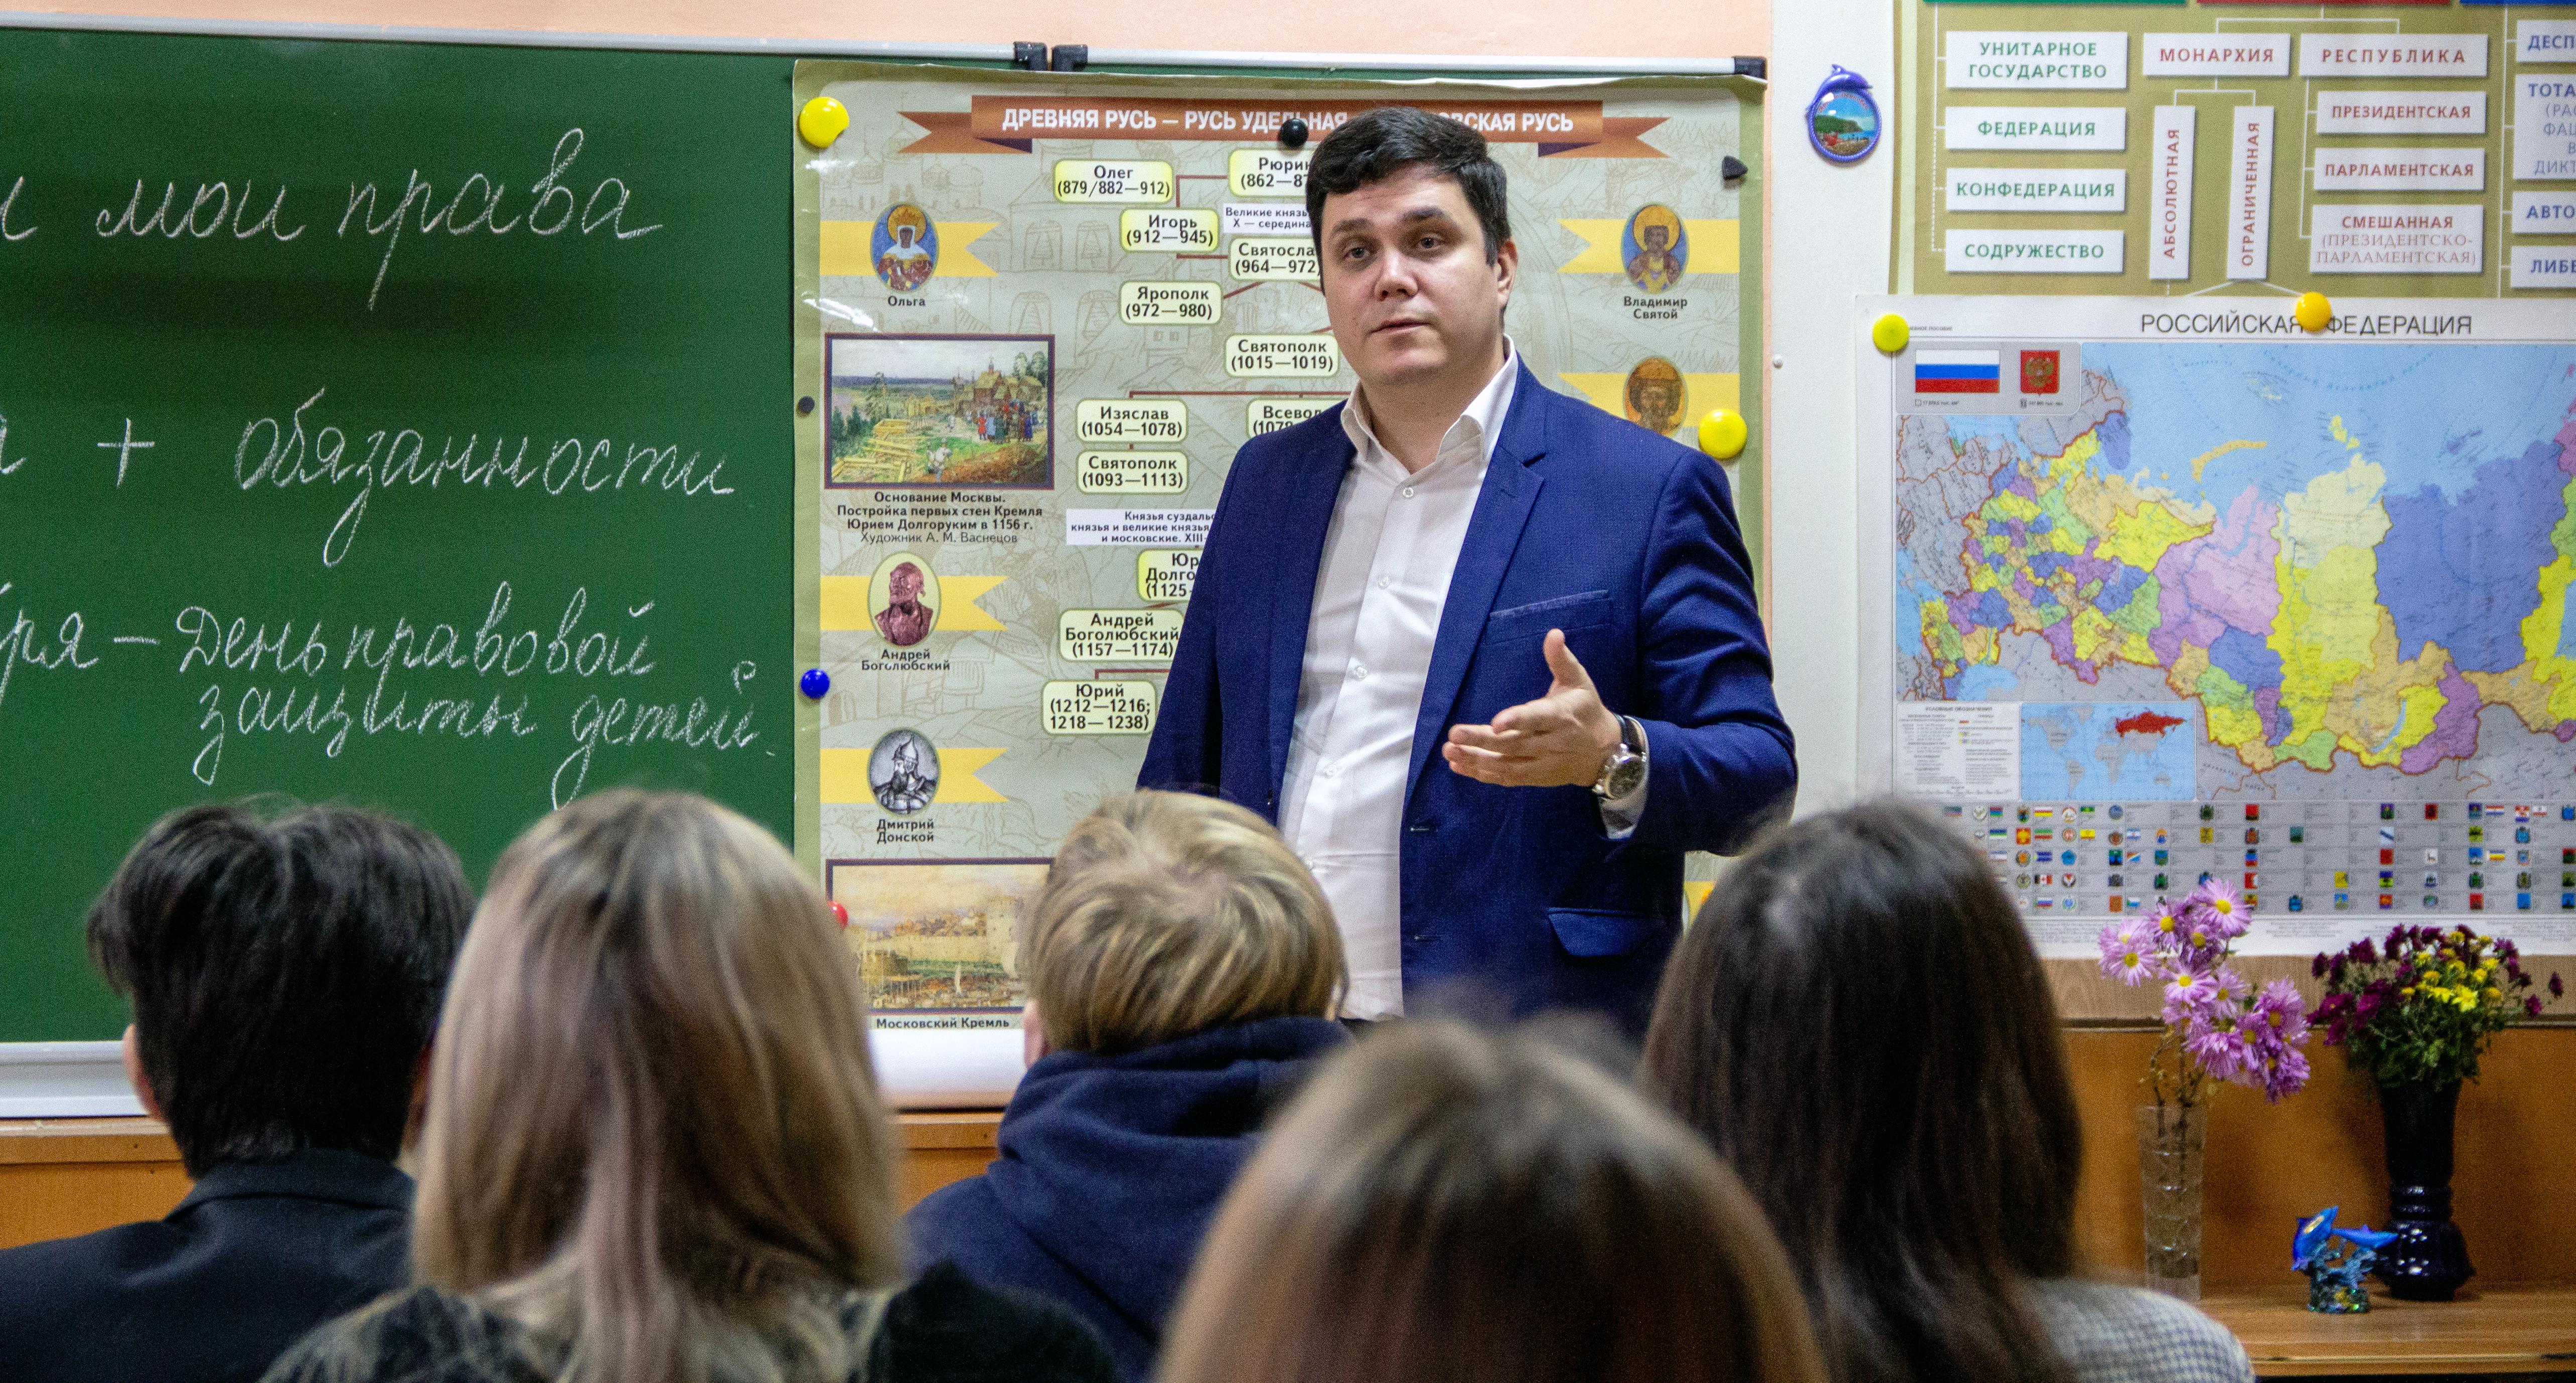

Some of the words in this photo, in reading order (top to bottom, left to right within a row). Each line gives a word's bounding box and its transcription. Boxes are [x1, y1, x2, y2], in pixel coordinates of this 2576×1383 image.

[1980, 42, 2097, 56] УНИТАРНОЕ
[2528, 35, 2576, 51] ДЕСП
[2159, 48, 2275, 63] МОНАРХИЯ
[2322, 49, 2466, 64] РЕСПУБЛИКА
[1968, 64, 2107, 80] ГОСУДАРСТВО
[1002, 108, 1099, 130] ДРЕВНЯЯ
[1106, 109, 1156, 129] РУСЬ
[1185, 110, 1237, 130] РУСЬ
[1522, 112, 1574, 132] РУСЬ
[2331, 104, 2471, 120] ПРЕЗИДЕНТСКАЯ
[1978, 121, 2096, 138] ФЕДЕРАЦИЯ
[1094, 166, 1133, 181] Олег
[2325, 163, 2474, 177] ПАРЛАМЕНТСКАЯ
[1057, 180, 1170, 198] (879/882—912)
[1956, 182, 2116, 200] КОНФЕДЕРАЦИЯ
[2164, 128, 2180, 259] АБСОЛЮТНАЯ
[2241, 121, 2260, 266] ОГРАНИЧЕННАЯ
[95, 178, 306, 240] мои
[338, 127, 663, 311] права
[1226, 206, 1272, 217] Великие
[1148, 216, 1198, 233] Игорь
[2342, 215, 2454, 229] СМЕШАННАЯ
[1126, 229, 1214, 247] (912—945)
[2322, 233, 2473, 249] (ПРЕЗИДЕНТСКО-
[1239, 243, 1315, 256] Святосла
[1964, 243, 2105, 260] СОДРУЖЕСТВО
[2316, 249, 2477, 266] ПАРЛАМЕНТСКАЯ)
[887, 295, 926, 307] Ольга
[1137, 286, 1209, 303] Ярополк
[1623, 296, 1688, 309] Владимир
[1125, 303, 1212, 320] (972—980)
[1633, 309, 1678, 320] Святой
[2141, 310, 2304, 334] РОССИЙСКАЯ
[2326, 315, 2472, 336] ФЕДЕРАЦИЯ
[1238, 339, 1327, 353] Святополк
[1231, 355, 1334, 372] (1015—1019)
[1100, 406, 1169, 420] Изяслав
[1081, 421, 1182, 439] (1054—1078)
[1089, 455, 1177, 470] Святополк
[1082, 472, 1183, 489] (1093—1113)
[874, 492, 947, 503] Основание
[951, 492, 1006, 503] Москвы.
[837, 505, 906, 518] Постройка
[911, 508, 958, 518] первых
[962, 508, 991, 517] стен
[994, 506, 1043, 519] Кремля
[1125, 512, 1163, 521] Князья
[848, 519, 893, 532] Юрием
[897, 519, 977, 532] Долгоруким
[981, 522, 988, 530] в
[992, 519, 1020, 530] 1156
[1024, 522, 1033, 530] г.
[1071, 524, 1109, 532] князья
[861, 532, 923, 544] Художник
[926, 532, 939, 543] А.
[943, 532, 957, 543] М.
[961, 532, 1018, 544] Васнецов
[1171, 553, 1199, 570] Юр
[1146, 567, 1196, 583] Долго
[1091, 612, 1154, 630] Андрей
[175, 604, 329, 675] День
[343, 579, 656, 701] правовой
[1066, 627, 1179, 641] Боголюбский
[881, 649, 931, 662] Андрей
[1073, 642, 1174, 658] (1157—1174)
[861, 660, 951, 671] Боголюбский
[1076, 684, 1124, 700] Юрий
[1050, 698, 1150, 715] (1212—1216;
[191, 684, 537, 786] защиты
[876, 818, 935, 832] Дмитрий
[876, 831, 935, 844] Донской
[876, 1018, 957, 1028] Московский
[961, 1018, 1009, 1029] Кремль
